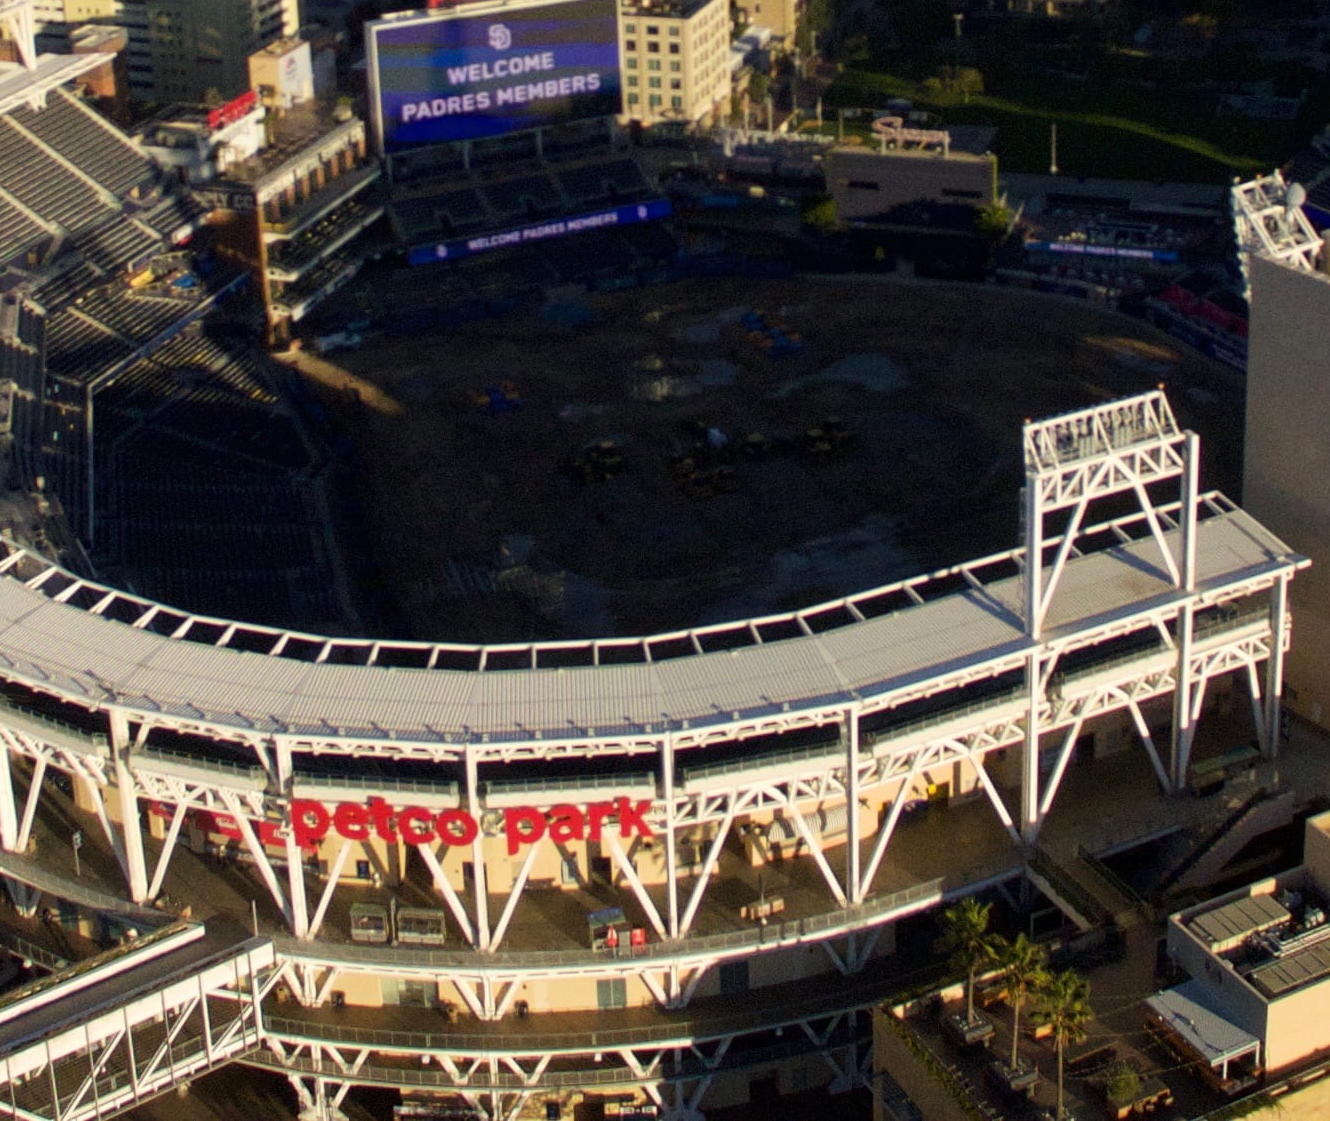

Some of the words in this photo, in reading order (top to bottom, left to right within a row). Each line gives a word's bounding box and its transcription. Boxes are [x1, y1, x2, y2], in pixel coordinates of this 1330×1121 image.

[446, 51, 555, 85] WELCOME
[402, 92, 491, 122] PADRES
[496, 72, 602, 107] MEMBERS
[469, 229, 521, 250] WELCOME
[523, 222, 566, 240] PADRES
[568, 212, 619, 231] MEMBERS
[290, 796, 478, 852] petco
[504, 795, 655, 855] park
